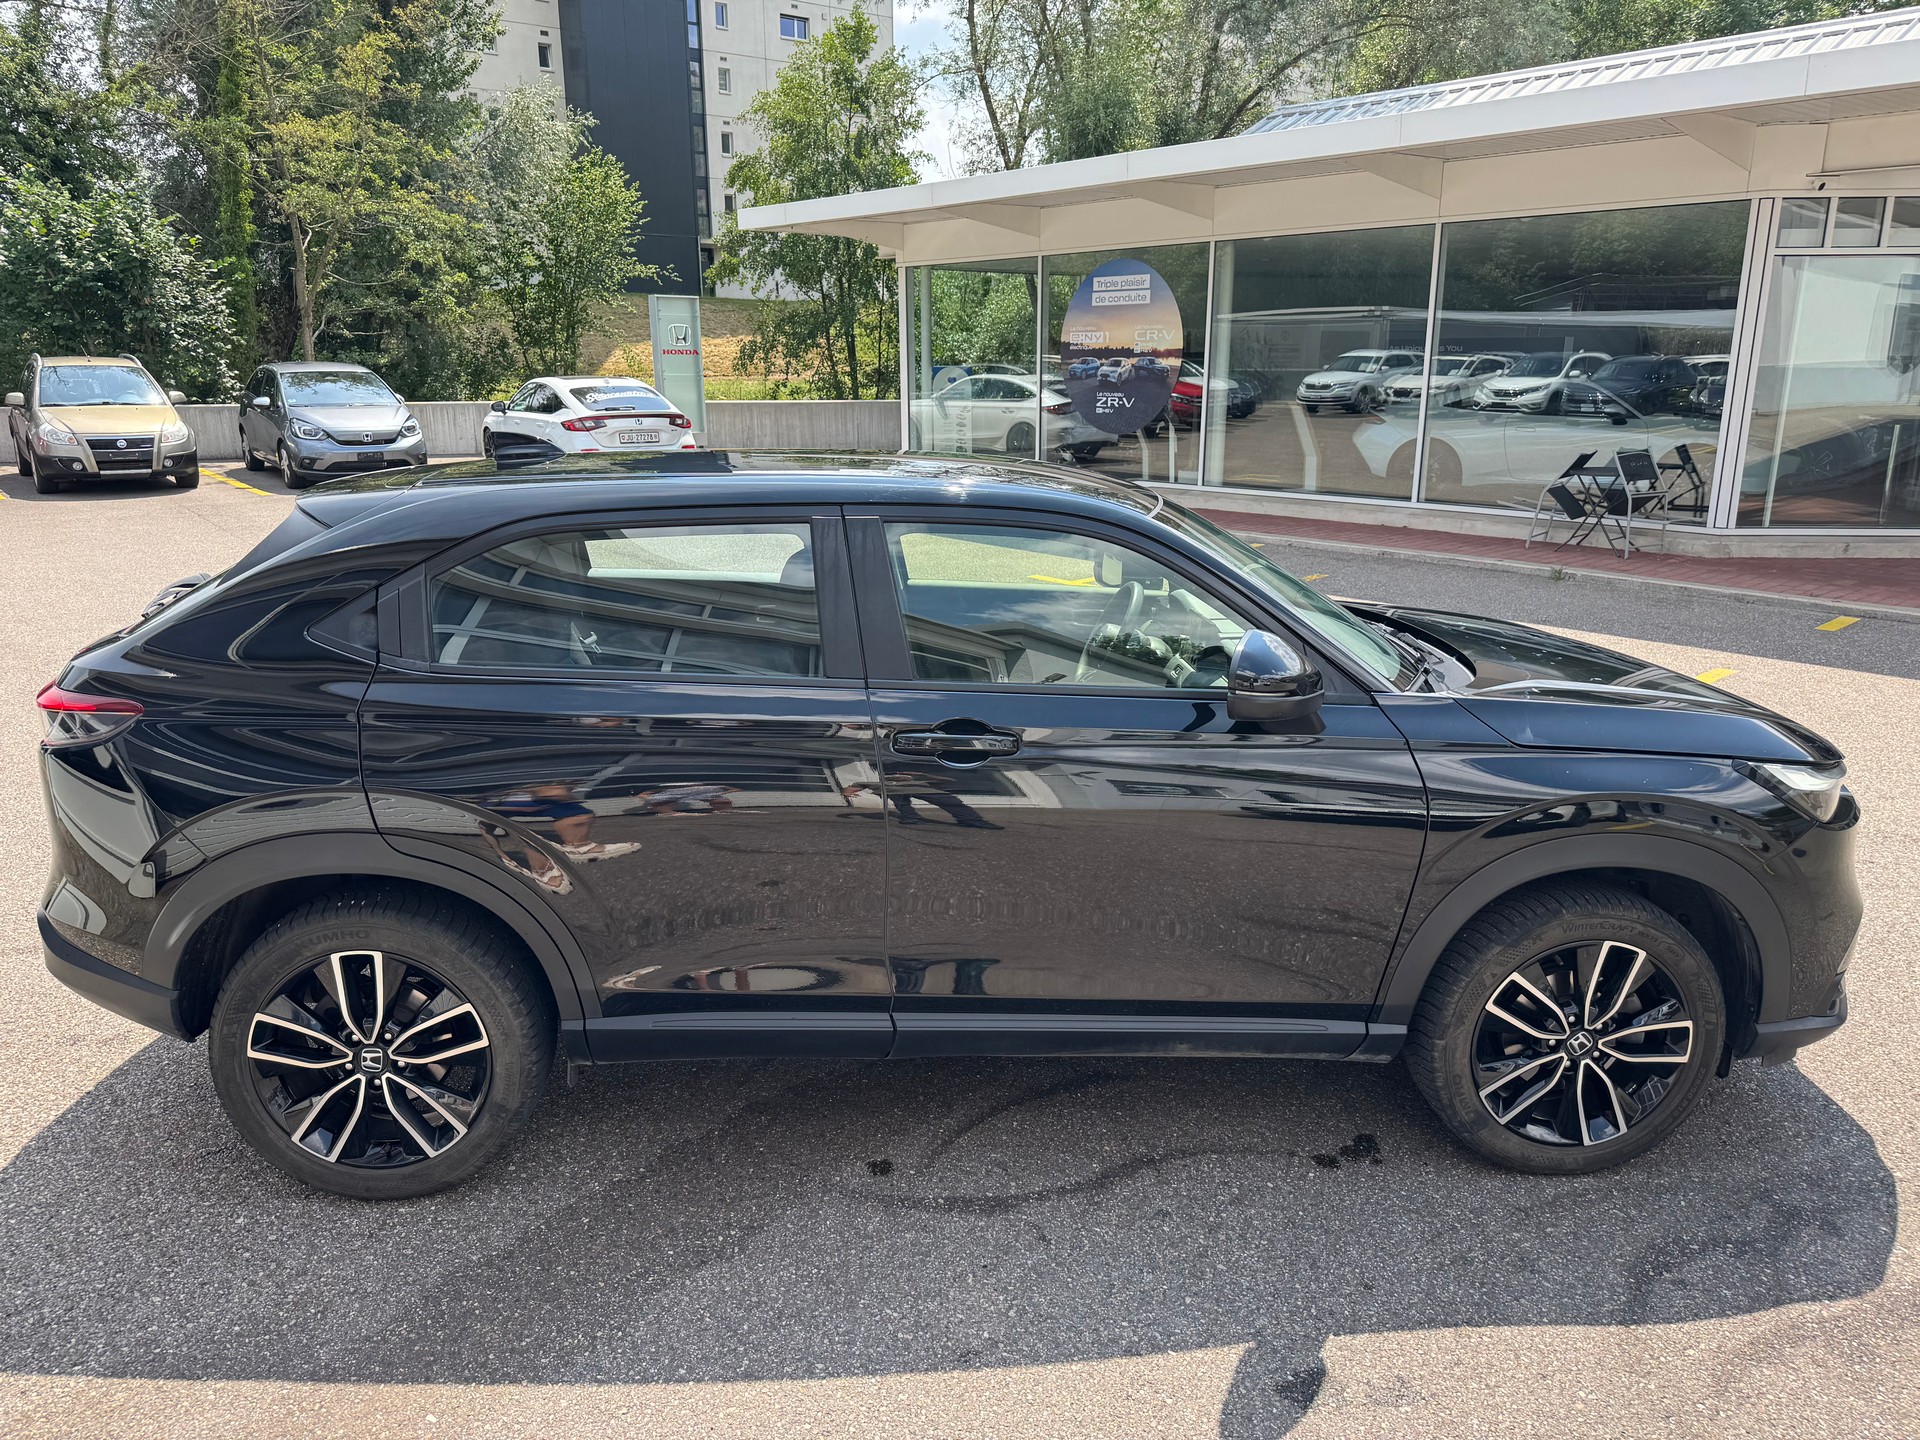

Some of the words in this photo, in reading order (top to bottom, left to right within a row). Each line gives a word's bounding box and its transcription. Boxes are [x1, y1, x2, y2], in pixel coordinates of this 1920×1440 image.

[1096, 280, 1119, 290] Triple
[1120, 277, 1146, 289] plaisir
[1095, 295, 1107, 304] de
[1107, 293, 1147, 303] conduite
[1134, 329, 1176, 341] CR-V
[1096, 396, 1135, 408] ZR-V
